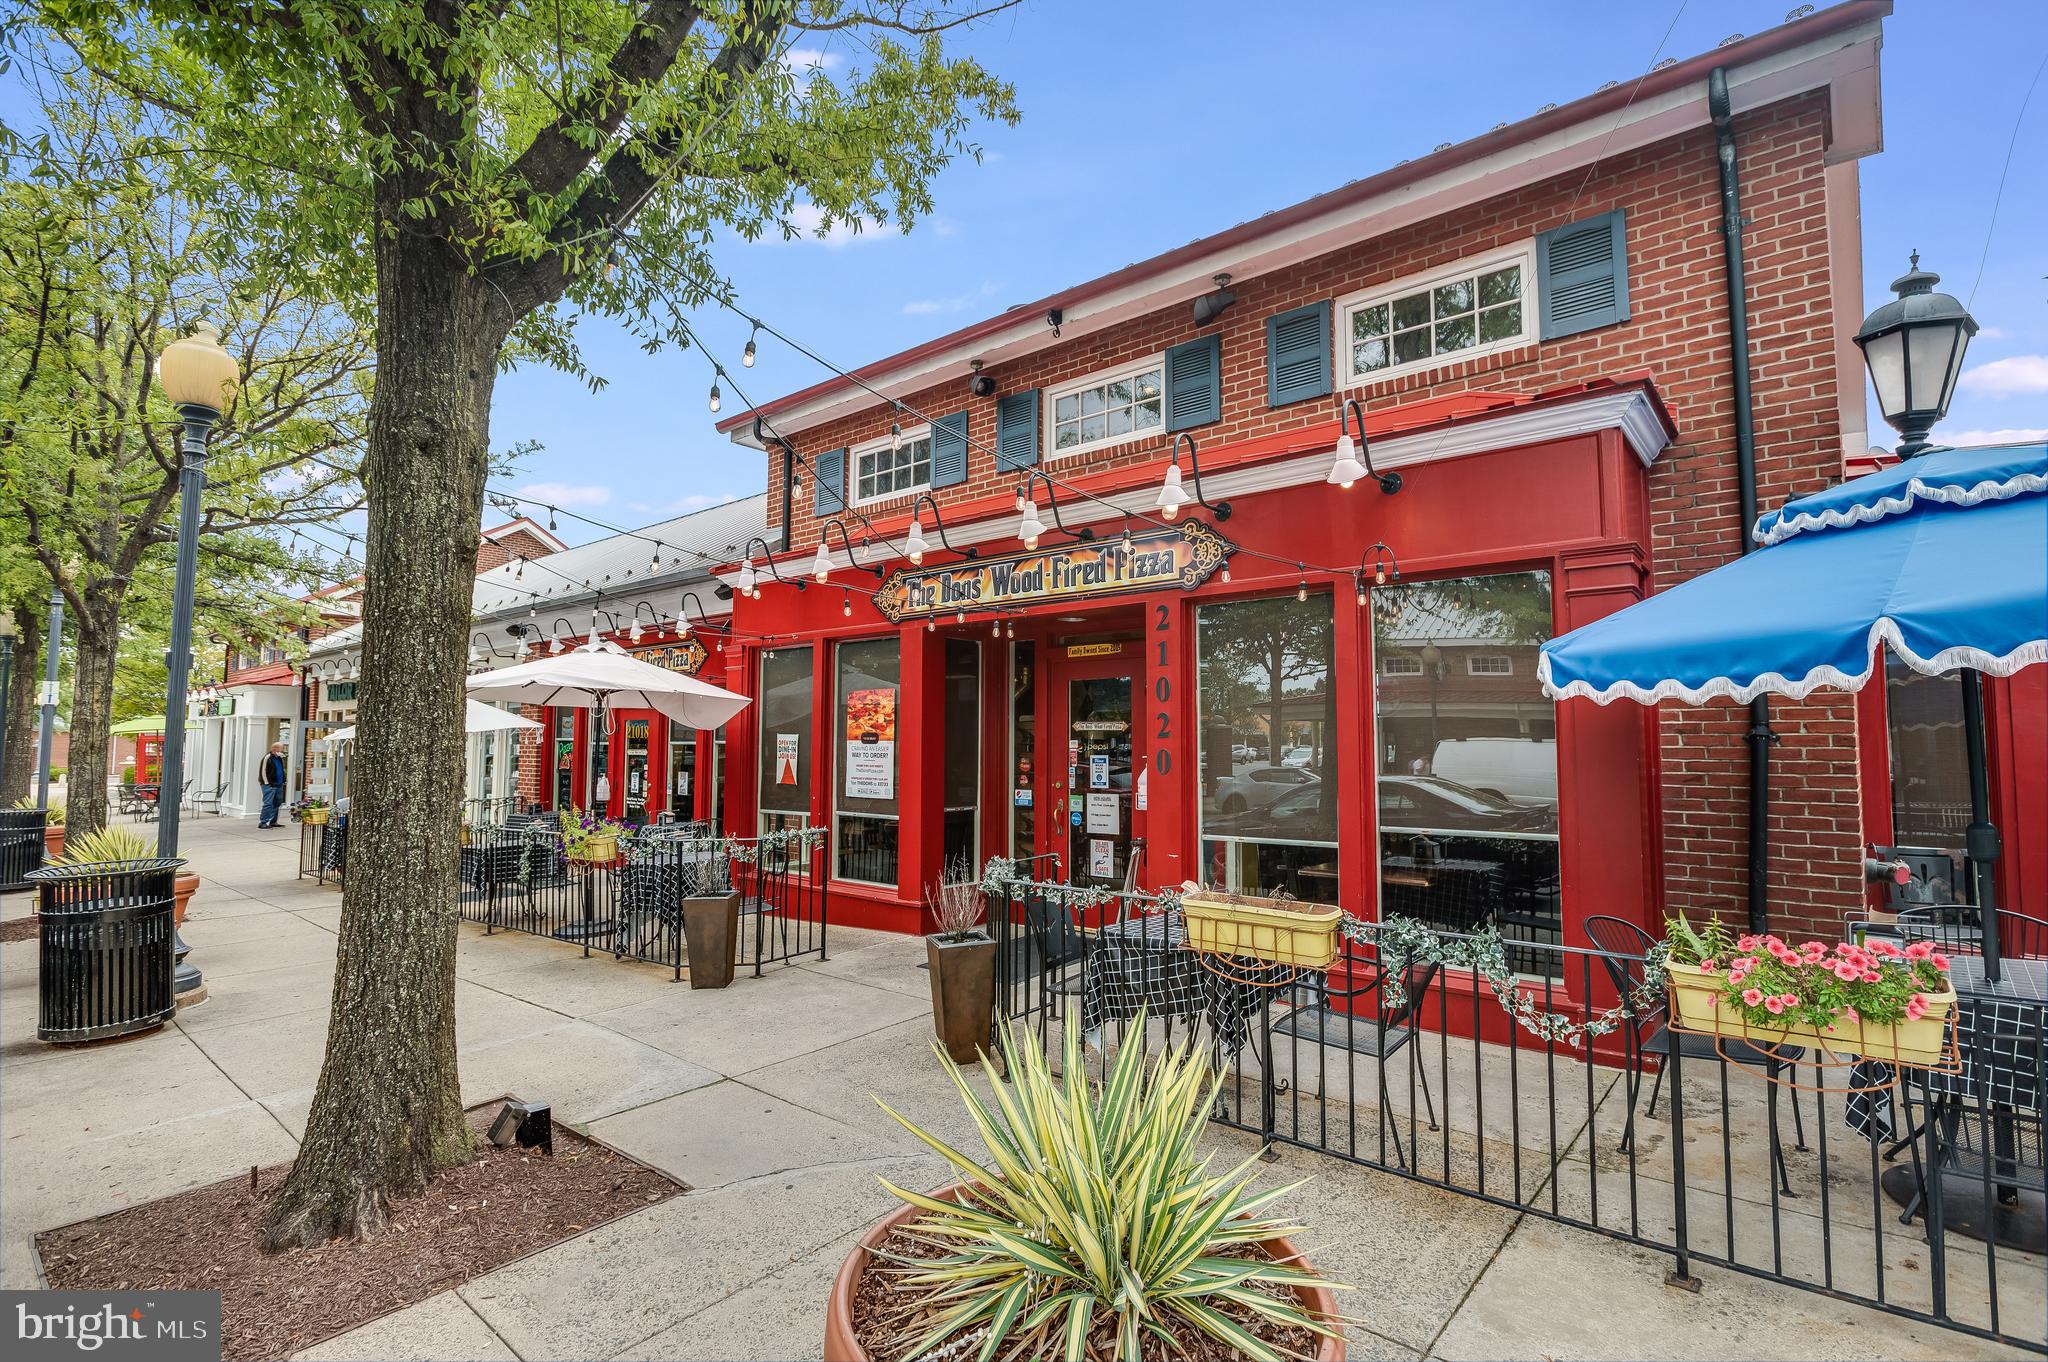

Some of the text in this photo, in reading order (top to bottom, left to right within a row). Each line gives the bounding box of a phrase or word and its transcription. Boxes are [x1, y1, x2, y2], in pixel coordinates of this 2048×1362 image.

[906, 545, 1175, 609] The Dons' Wood-Fired Pizza
[667, 647, 689, 668] Pizza
[327, 682, 354, 702] TAILOR
[1155, 604, 1172, 777] 21020
[626, 724, 649, 739] 21018
